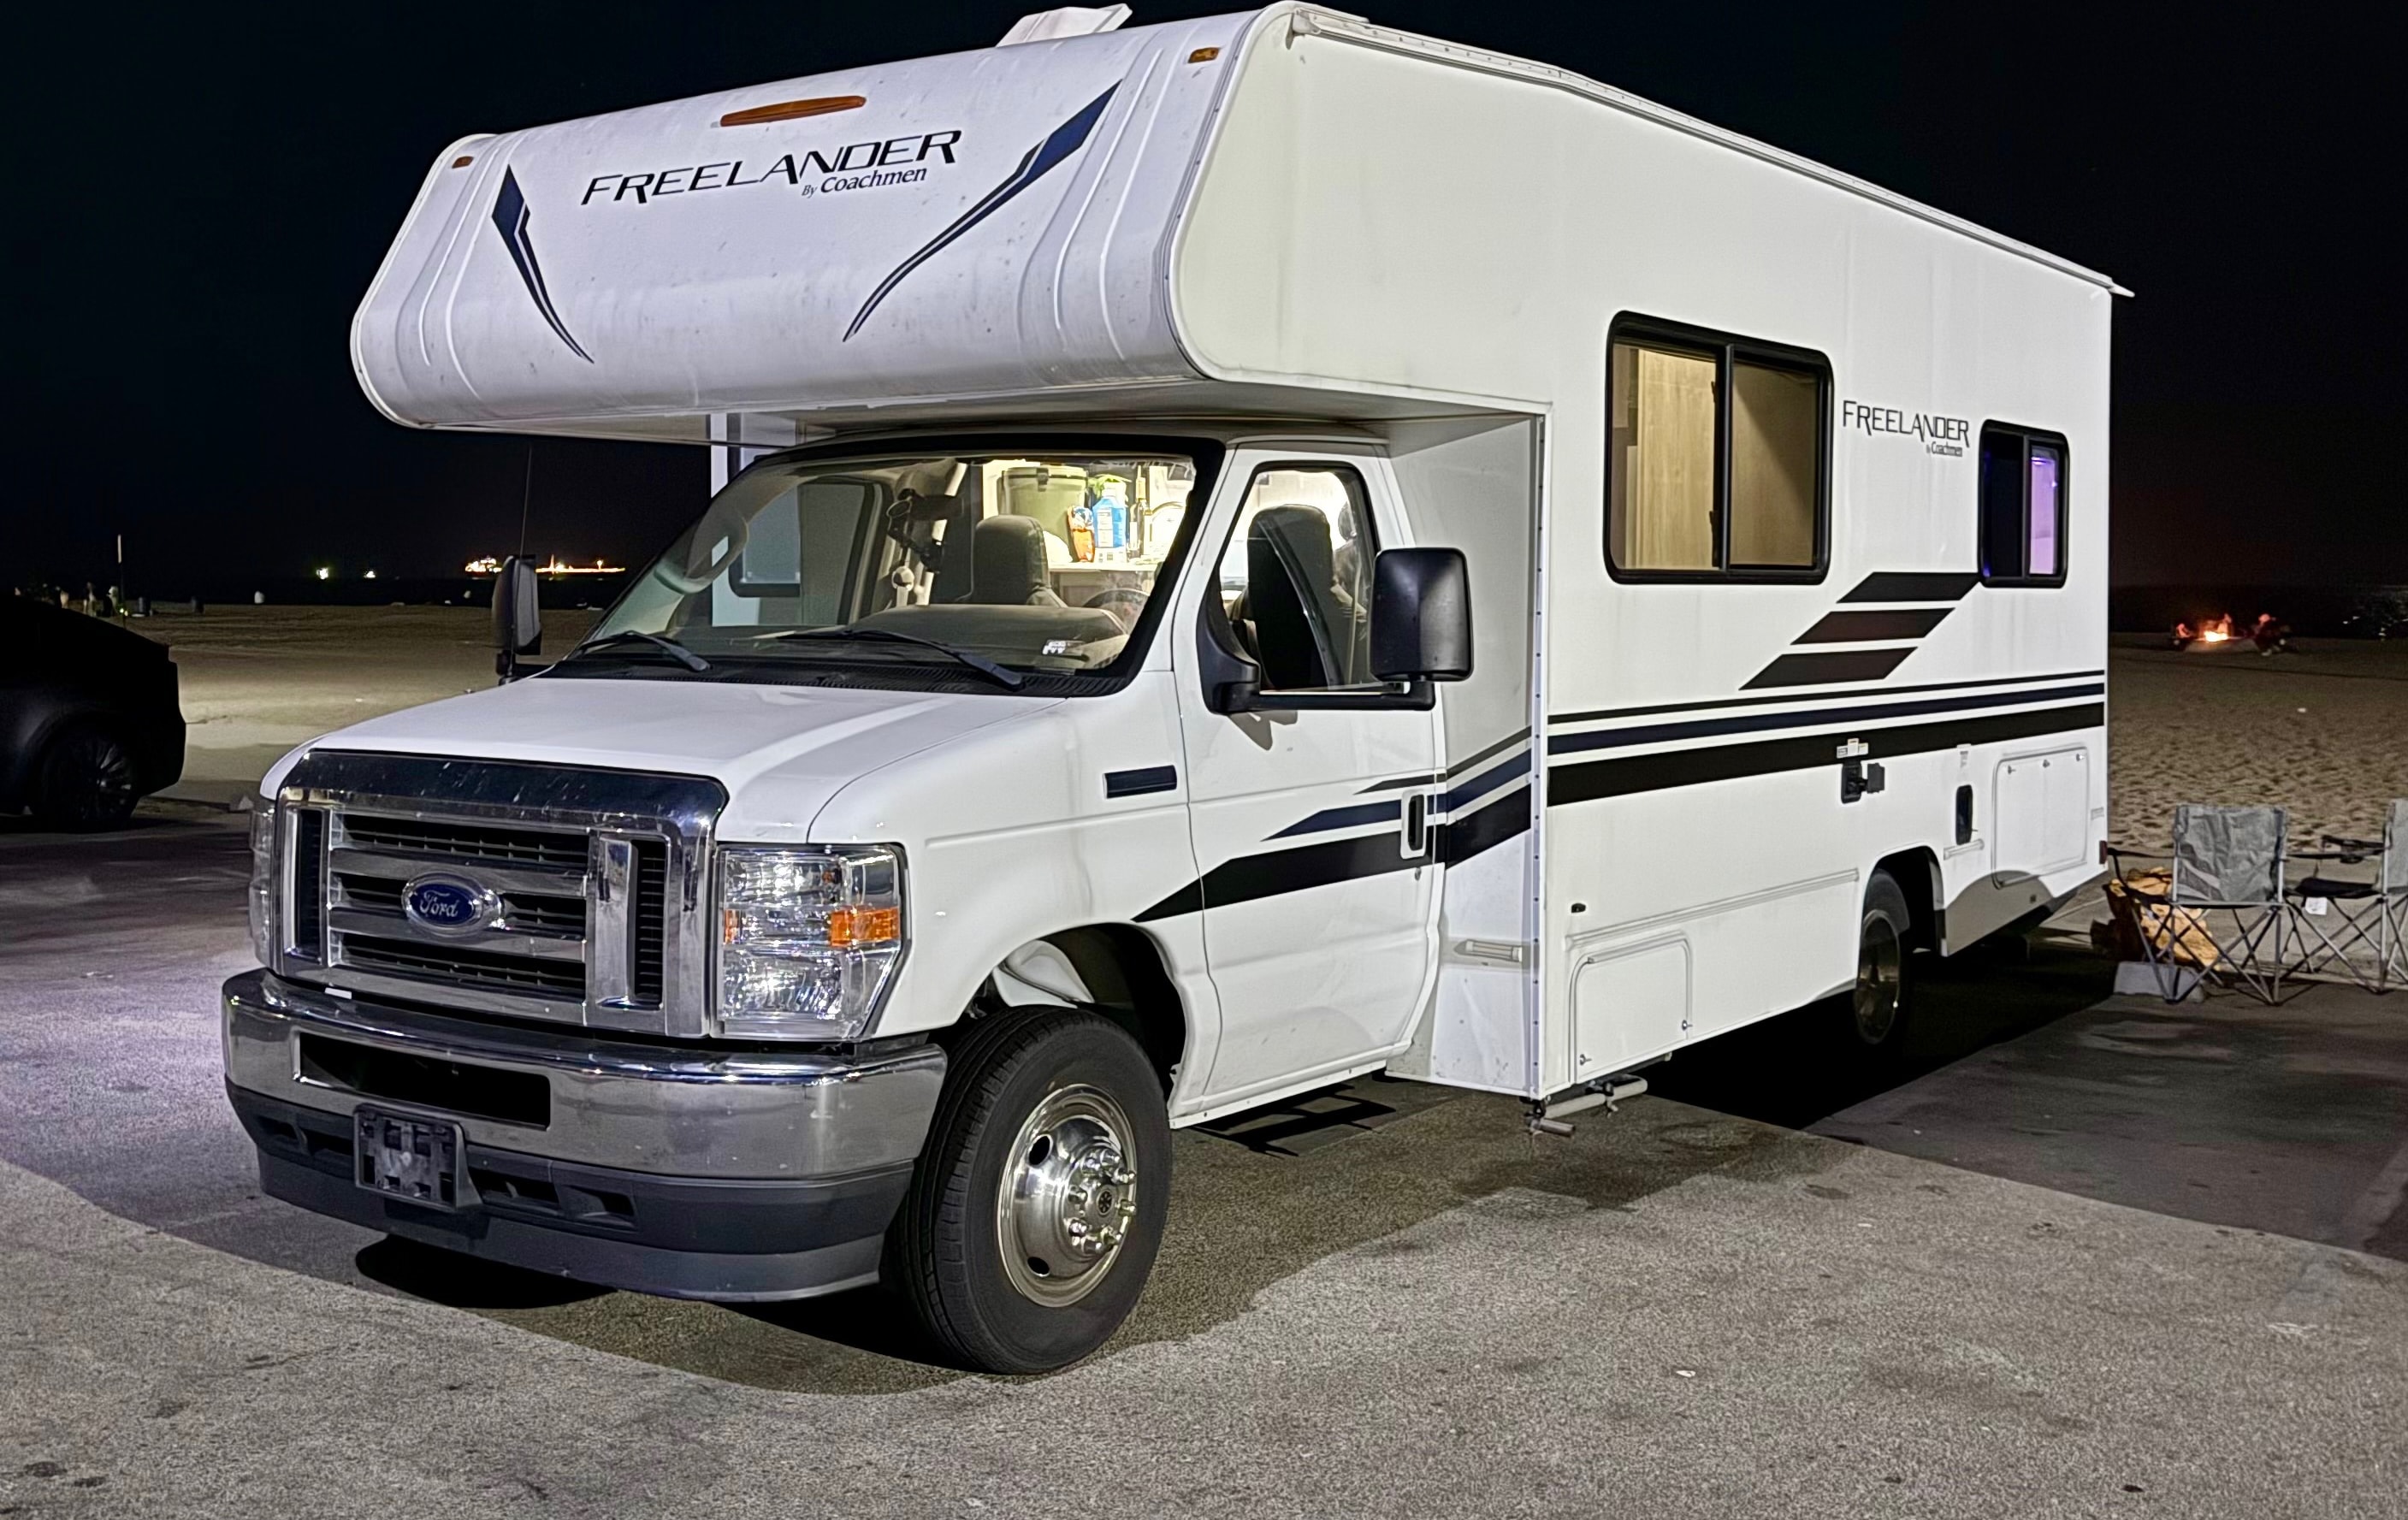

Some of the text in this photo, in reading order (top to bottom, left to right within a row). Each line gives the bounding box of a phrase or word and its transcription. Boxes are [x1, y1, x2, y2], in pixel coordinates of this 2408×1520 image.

[581, 130, 961, 205] FREELANDER
[802, 168, 927, 198] By Coachmen
[1843, 399, 1970, 448] FREELANDER
[419, 890, 459, 918] Ford
